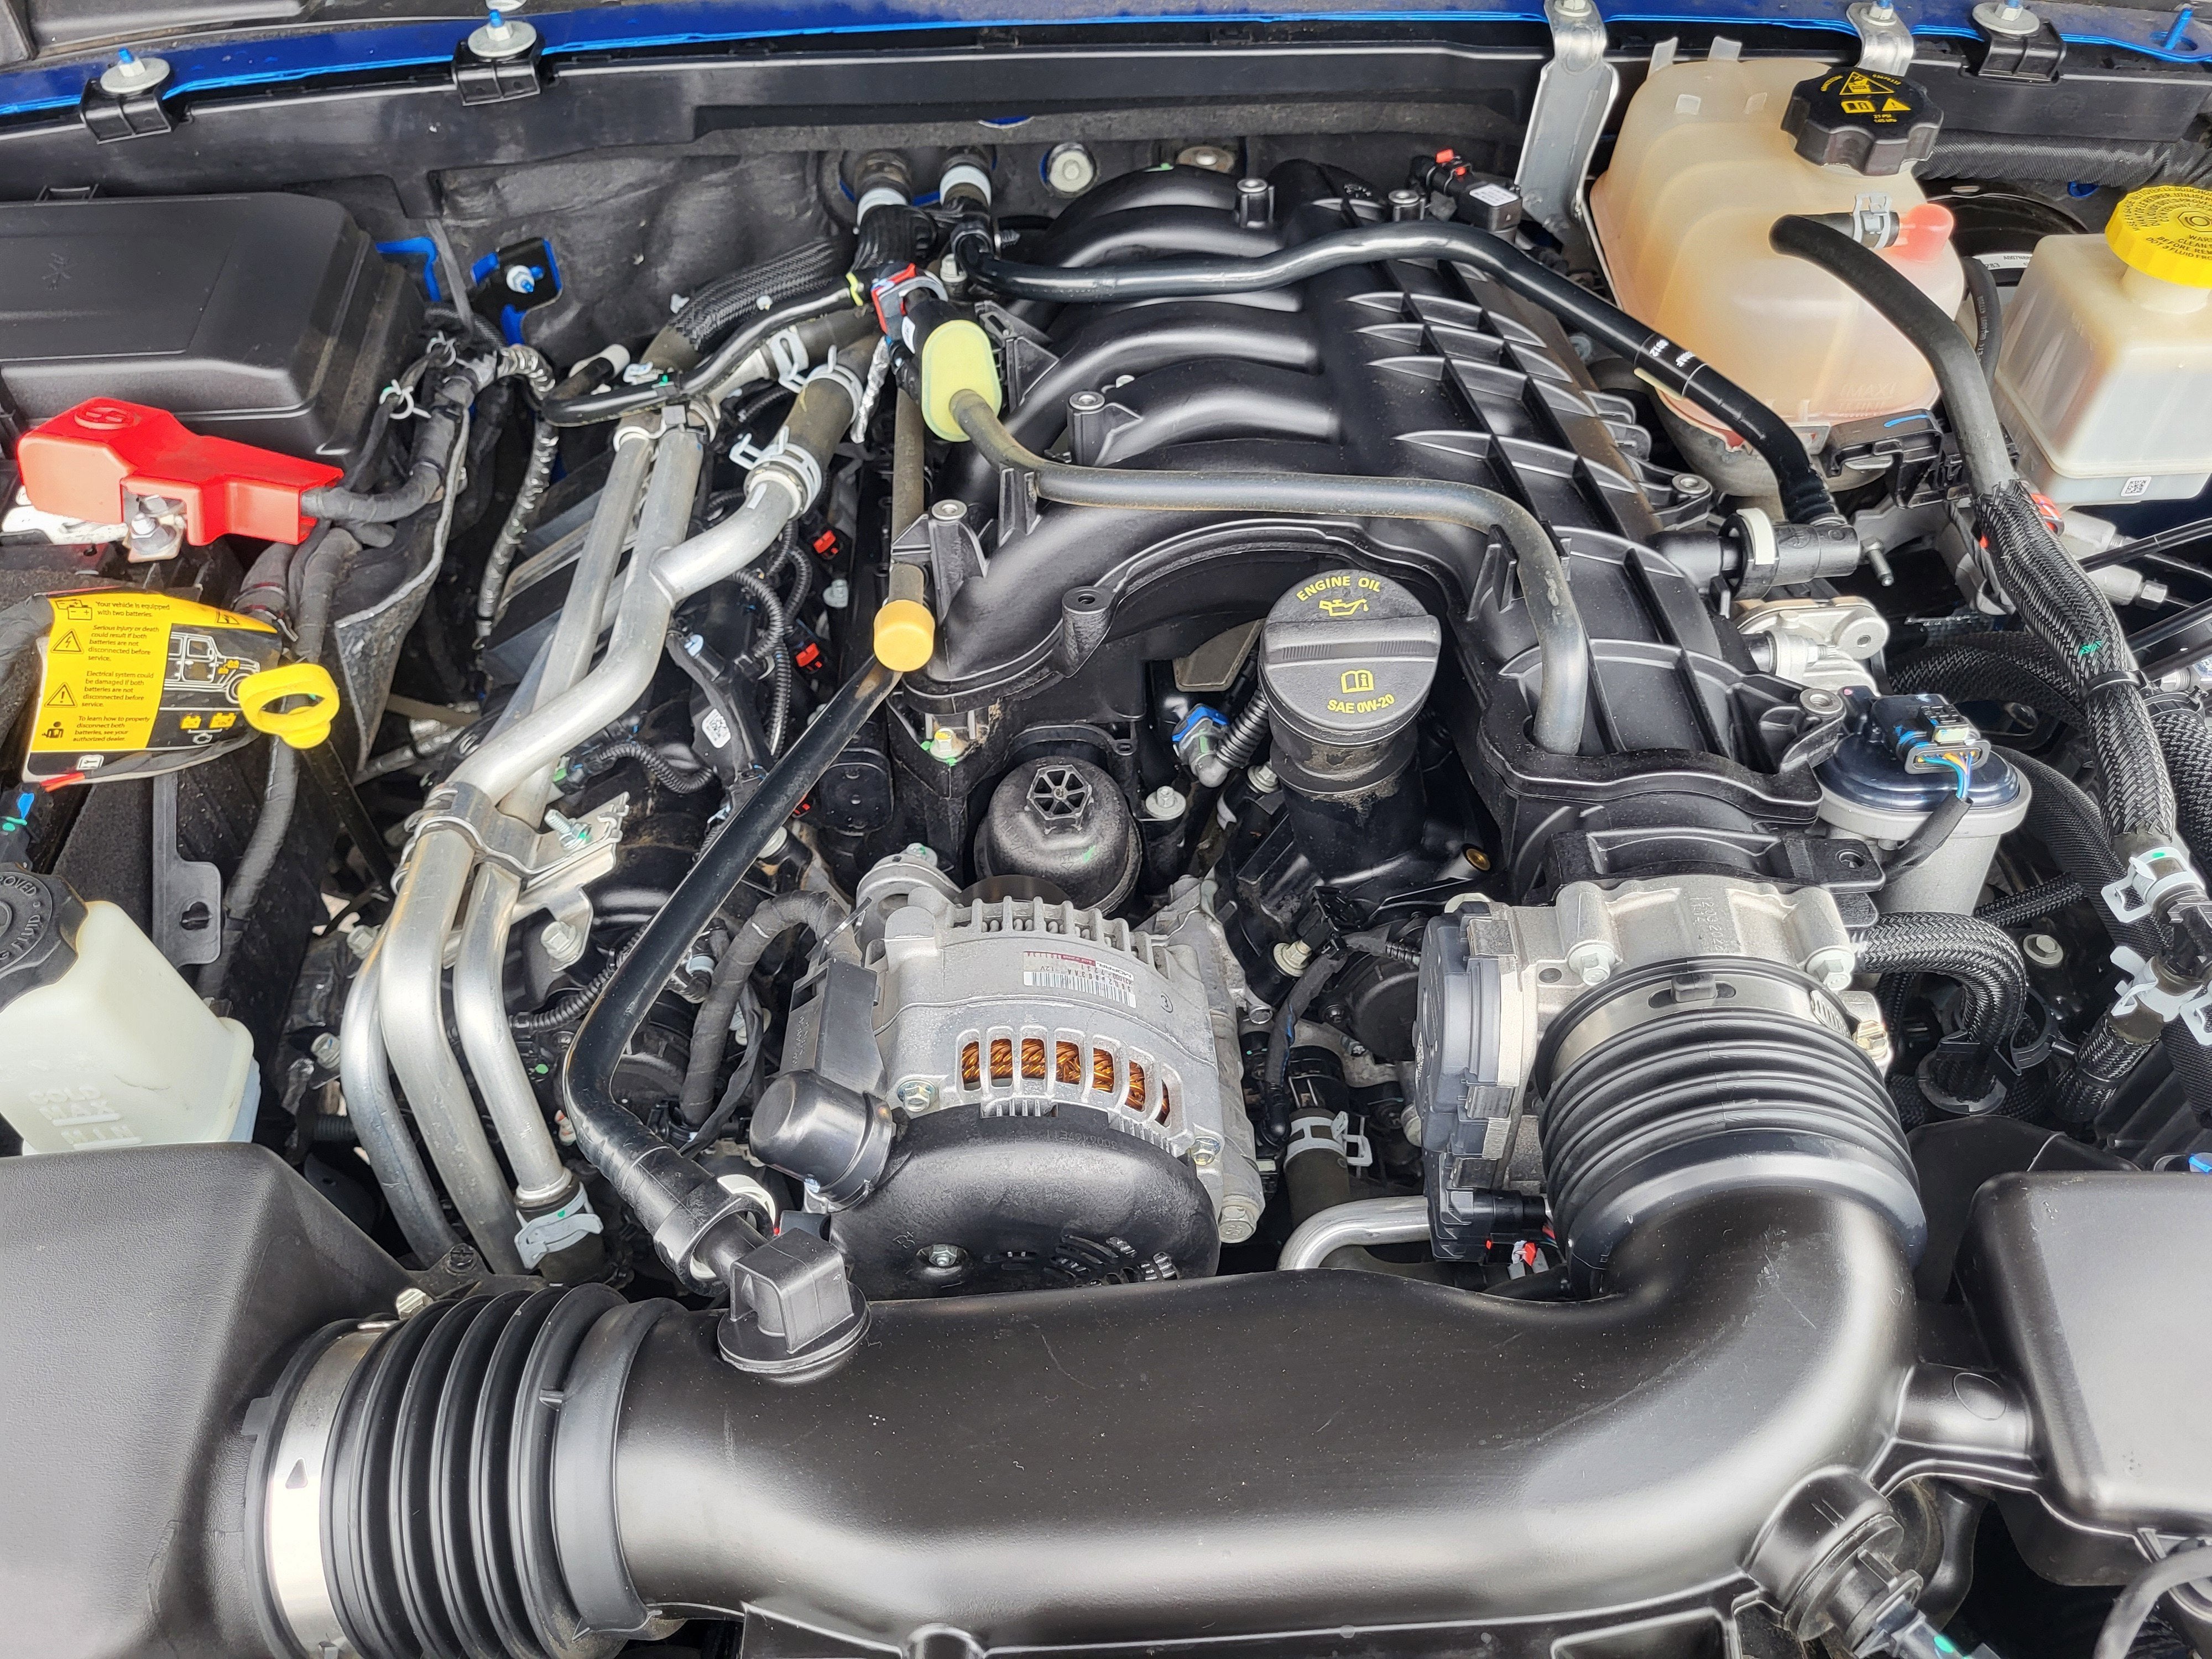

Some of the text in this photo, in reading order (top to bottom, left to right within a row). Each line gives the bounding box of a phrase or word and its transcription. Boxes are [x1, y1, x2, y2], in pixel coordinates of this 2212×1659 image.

[2175, 186, 2212, 196] BOUCHO
[2146, 237, 2163, 246] DOT
[2169, 248, 2194, 257] FLUID
[2157, 236, 2192, 251] BEFORE
[2178, 238, 2207, 248] CLEAN
[1296, 575, 1382, 602] ENGINE OIL
[1327, 693, 1395, 714] SAE 0W-20
[11, 914, 43, 951] FLUID
[29, 1086, 101, 1105] COLD
[39, 1099, 115, 1120] MAX
[61, 1125, 136, 1145] MIN
